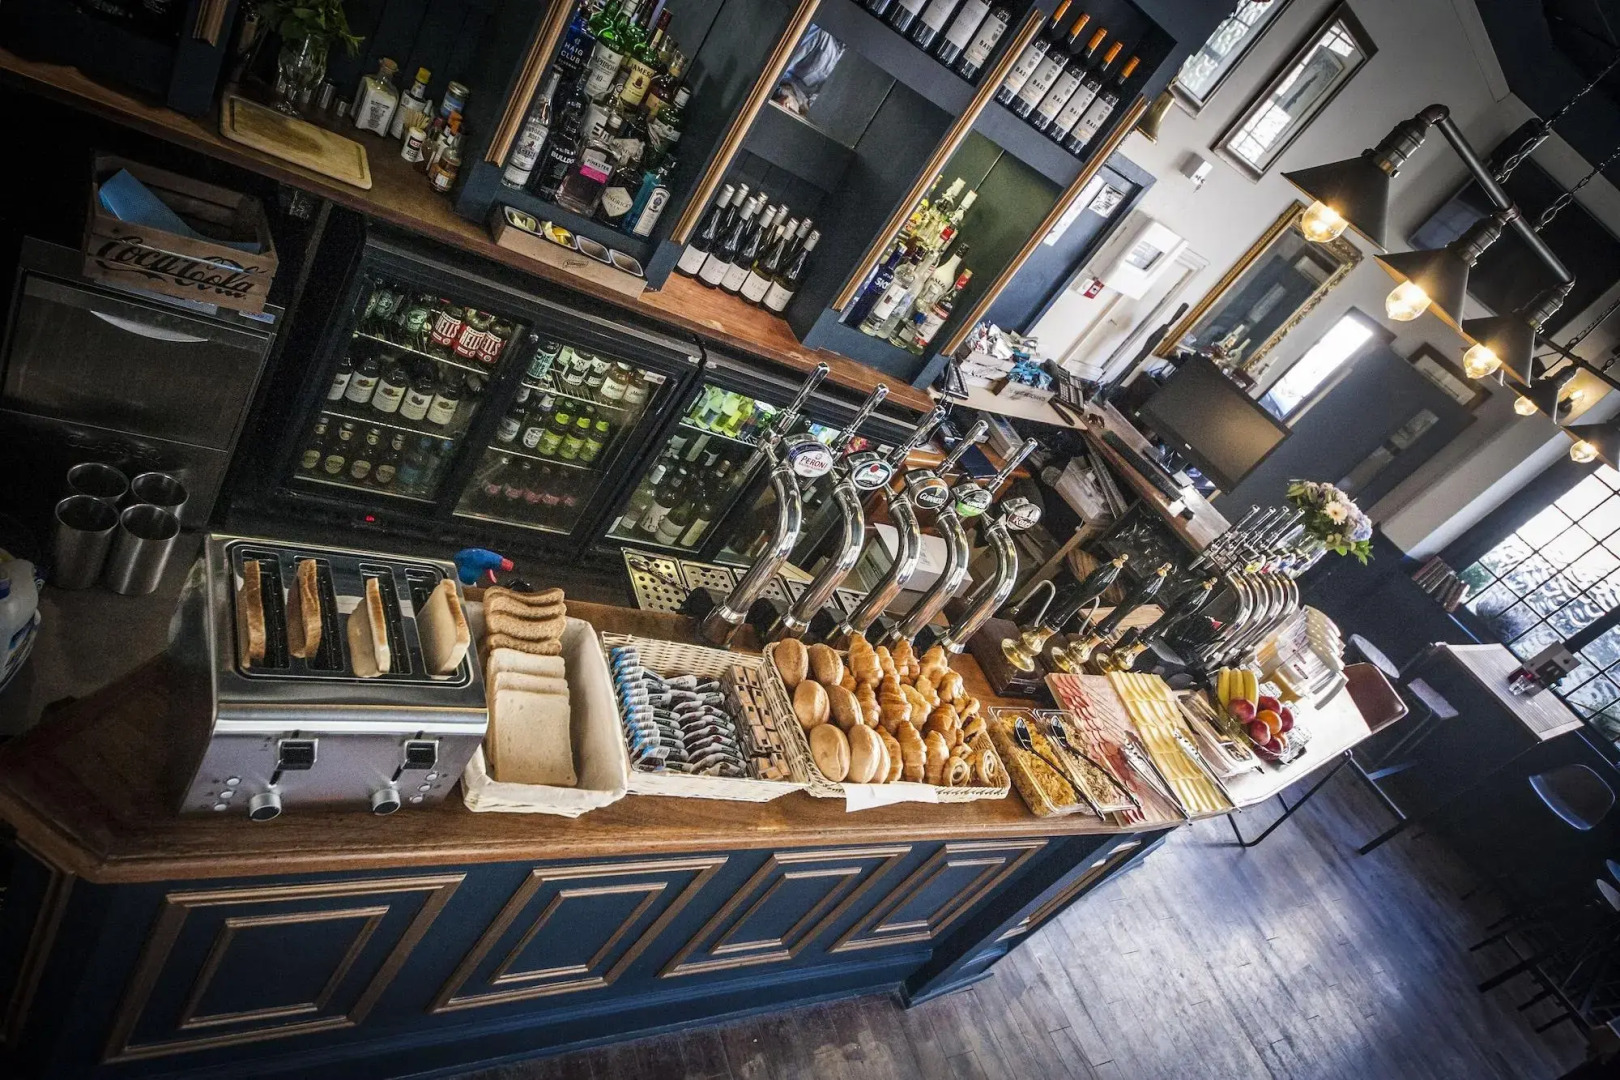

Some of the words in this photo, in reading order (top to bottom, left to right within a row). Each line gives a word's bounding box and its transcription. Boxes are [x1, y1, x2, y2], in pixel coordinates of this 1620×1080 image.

[564, 42, 584, 56] HAIG
[560, 50, 580, 64] CLUB
[586, 159, 612, 172] PINKSTER
[435, 316, 461, 339] HELLS
[800, 455, 828, 469] PERONI
